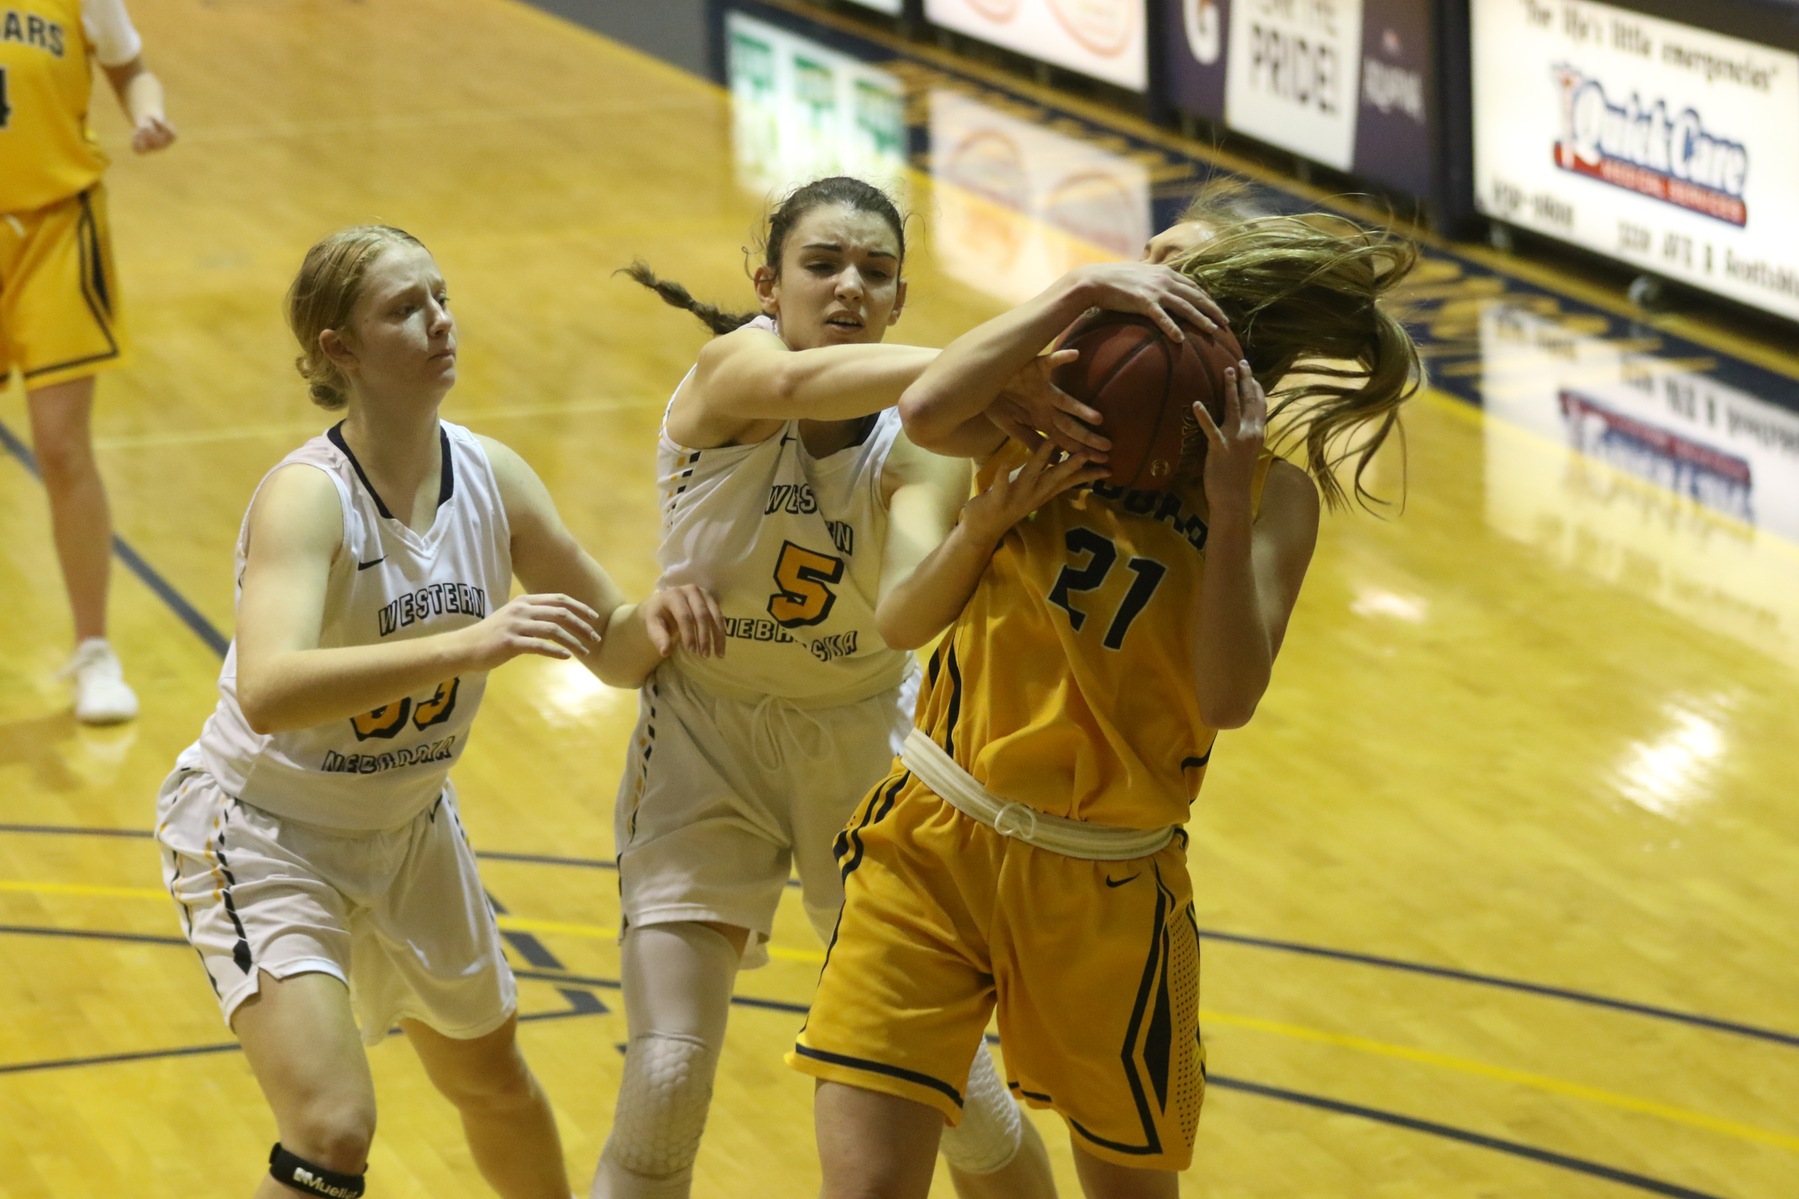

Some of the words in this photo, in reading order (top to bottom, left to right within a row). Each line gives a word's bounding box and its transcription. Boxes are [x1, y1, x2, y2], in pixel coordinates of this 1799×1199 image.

[378, 582, 486, 637] WESTERN
[766, 539, 845, 629] 5
[1047, 526, 1169, 651] 21
